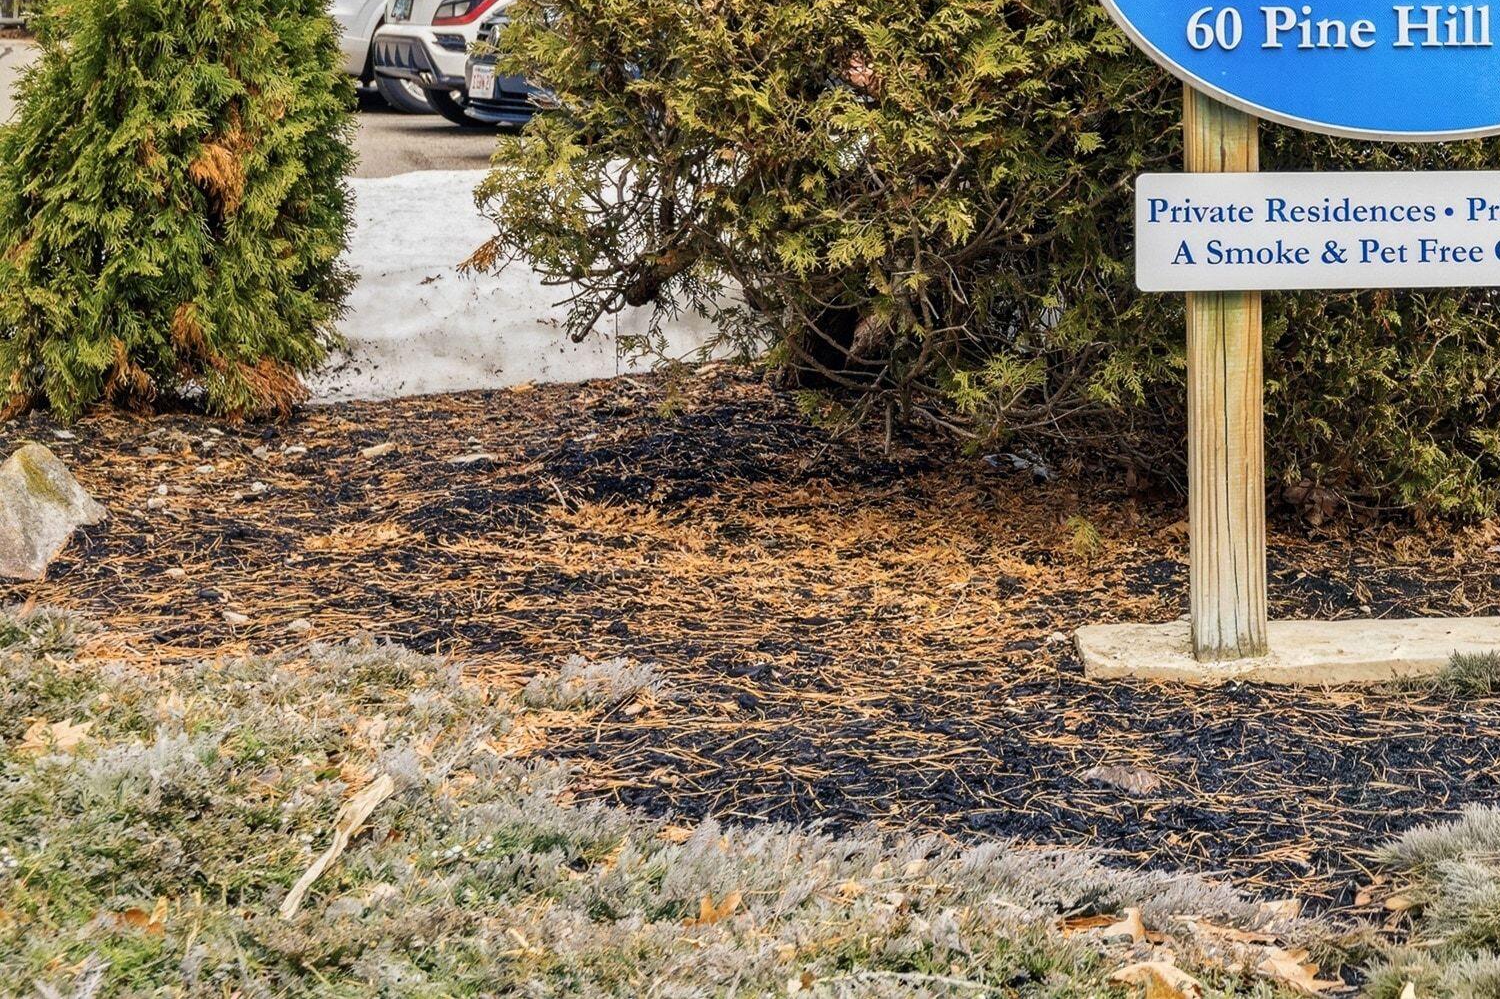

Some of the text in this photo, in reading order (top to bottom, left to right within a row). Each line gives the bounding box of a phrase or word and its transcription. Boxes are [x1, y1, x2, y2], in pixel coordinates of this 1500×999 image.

[1187, 7, 1242, 49] 60
[1261, 6, 1375, 47] Pine
[1393, 5, 1493, 45] Hill
[1148, 199, 1253, 222] Private
[1265, 198, 1436, 222] Residences
[1171, 240, 1196, 264] A
[1207, 240, 1309, 264] Smoke
[1321, 241, 1347, 264] &
[1359, 239, 1407, 263] Pet
[1418, 239, 1483, 262] Free
